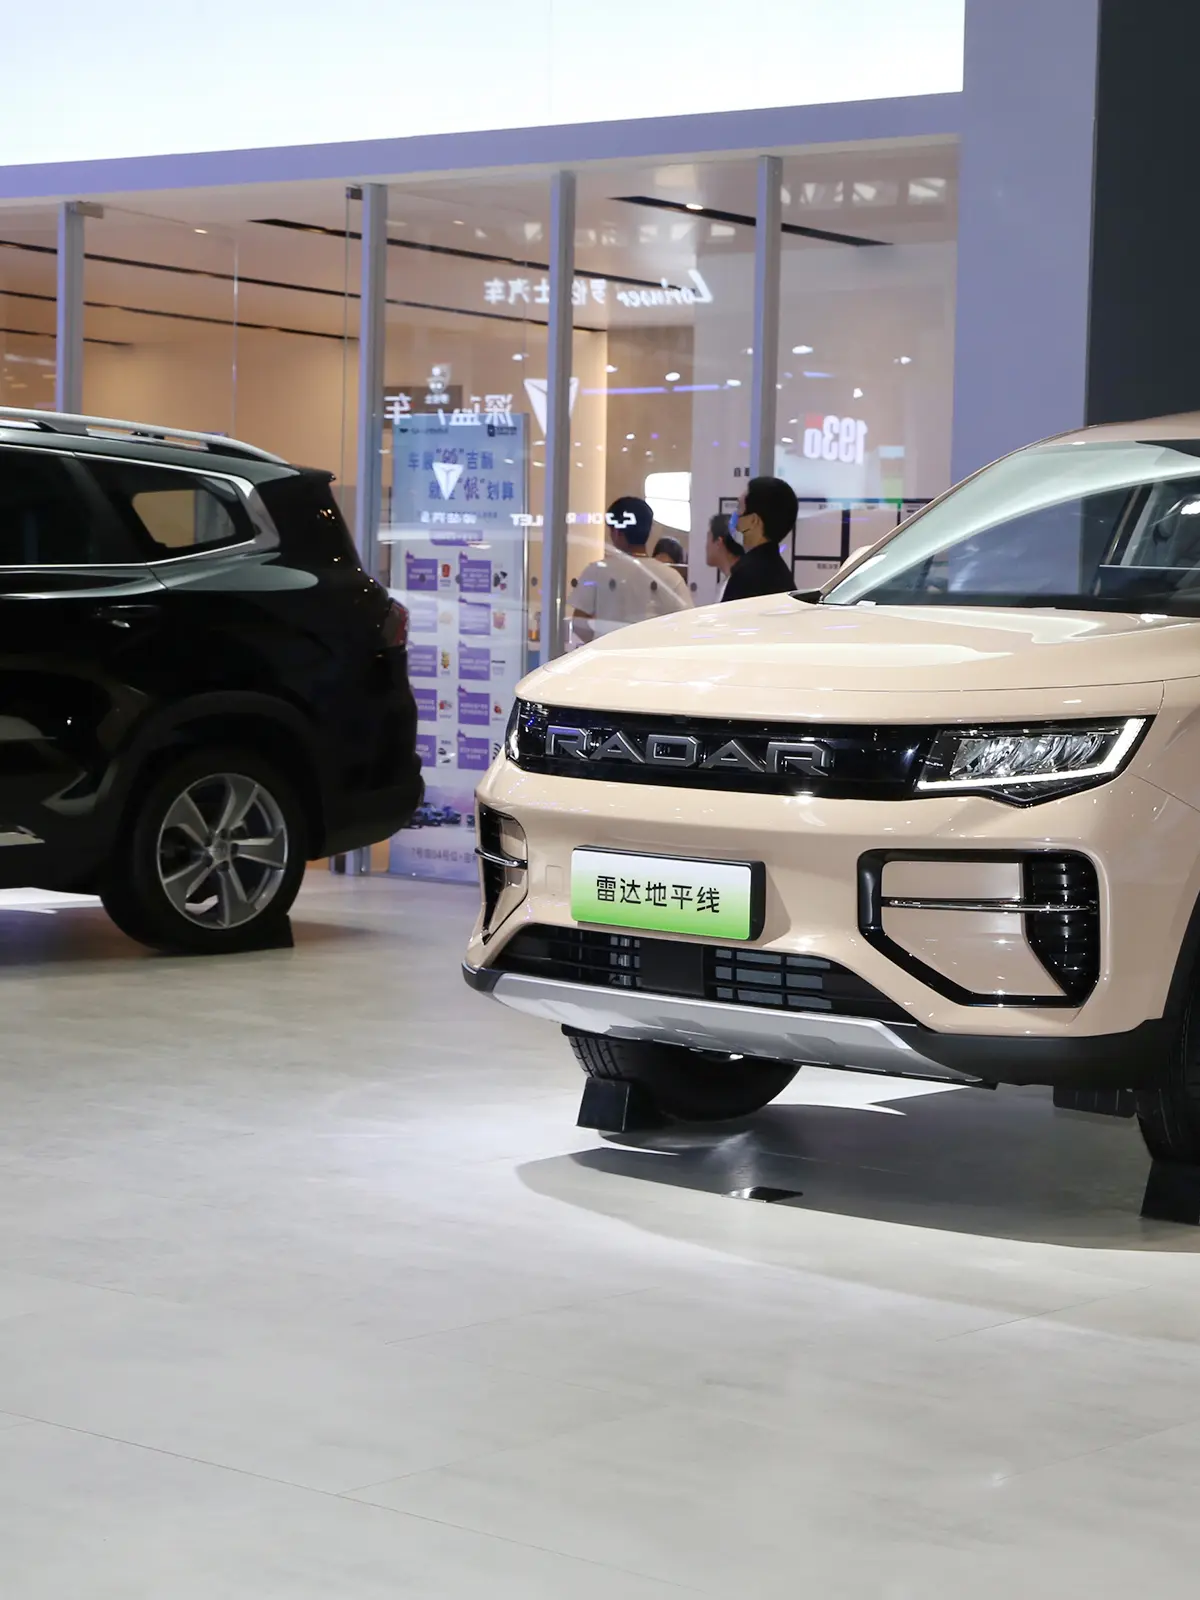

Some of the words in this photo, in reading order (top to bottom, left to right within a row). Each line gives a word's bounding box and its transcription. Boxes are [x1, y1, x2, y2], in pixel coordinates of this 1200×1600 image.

[546, 724, 834, 776] RADAR
[596, 875, 720, 913] 雷达地平线
